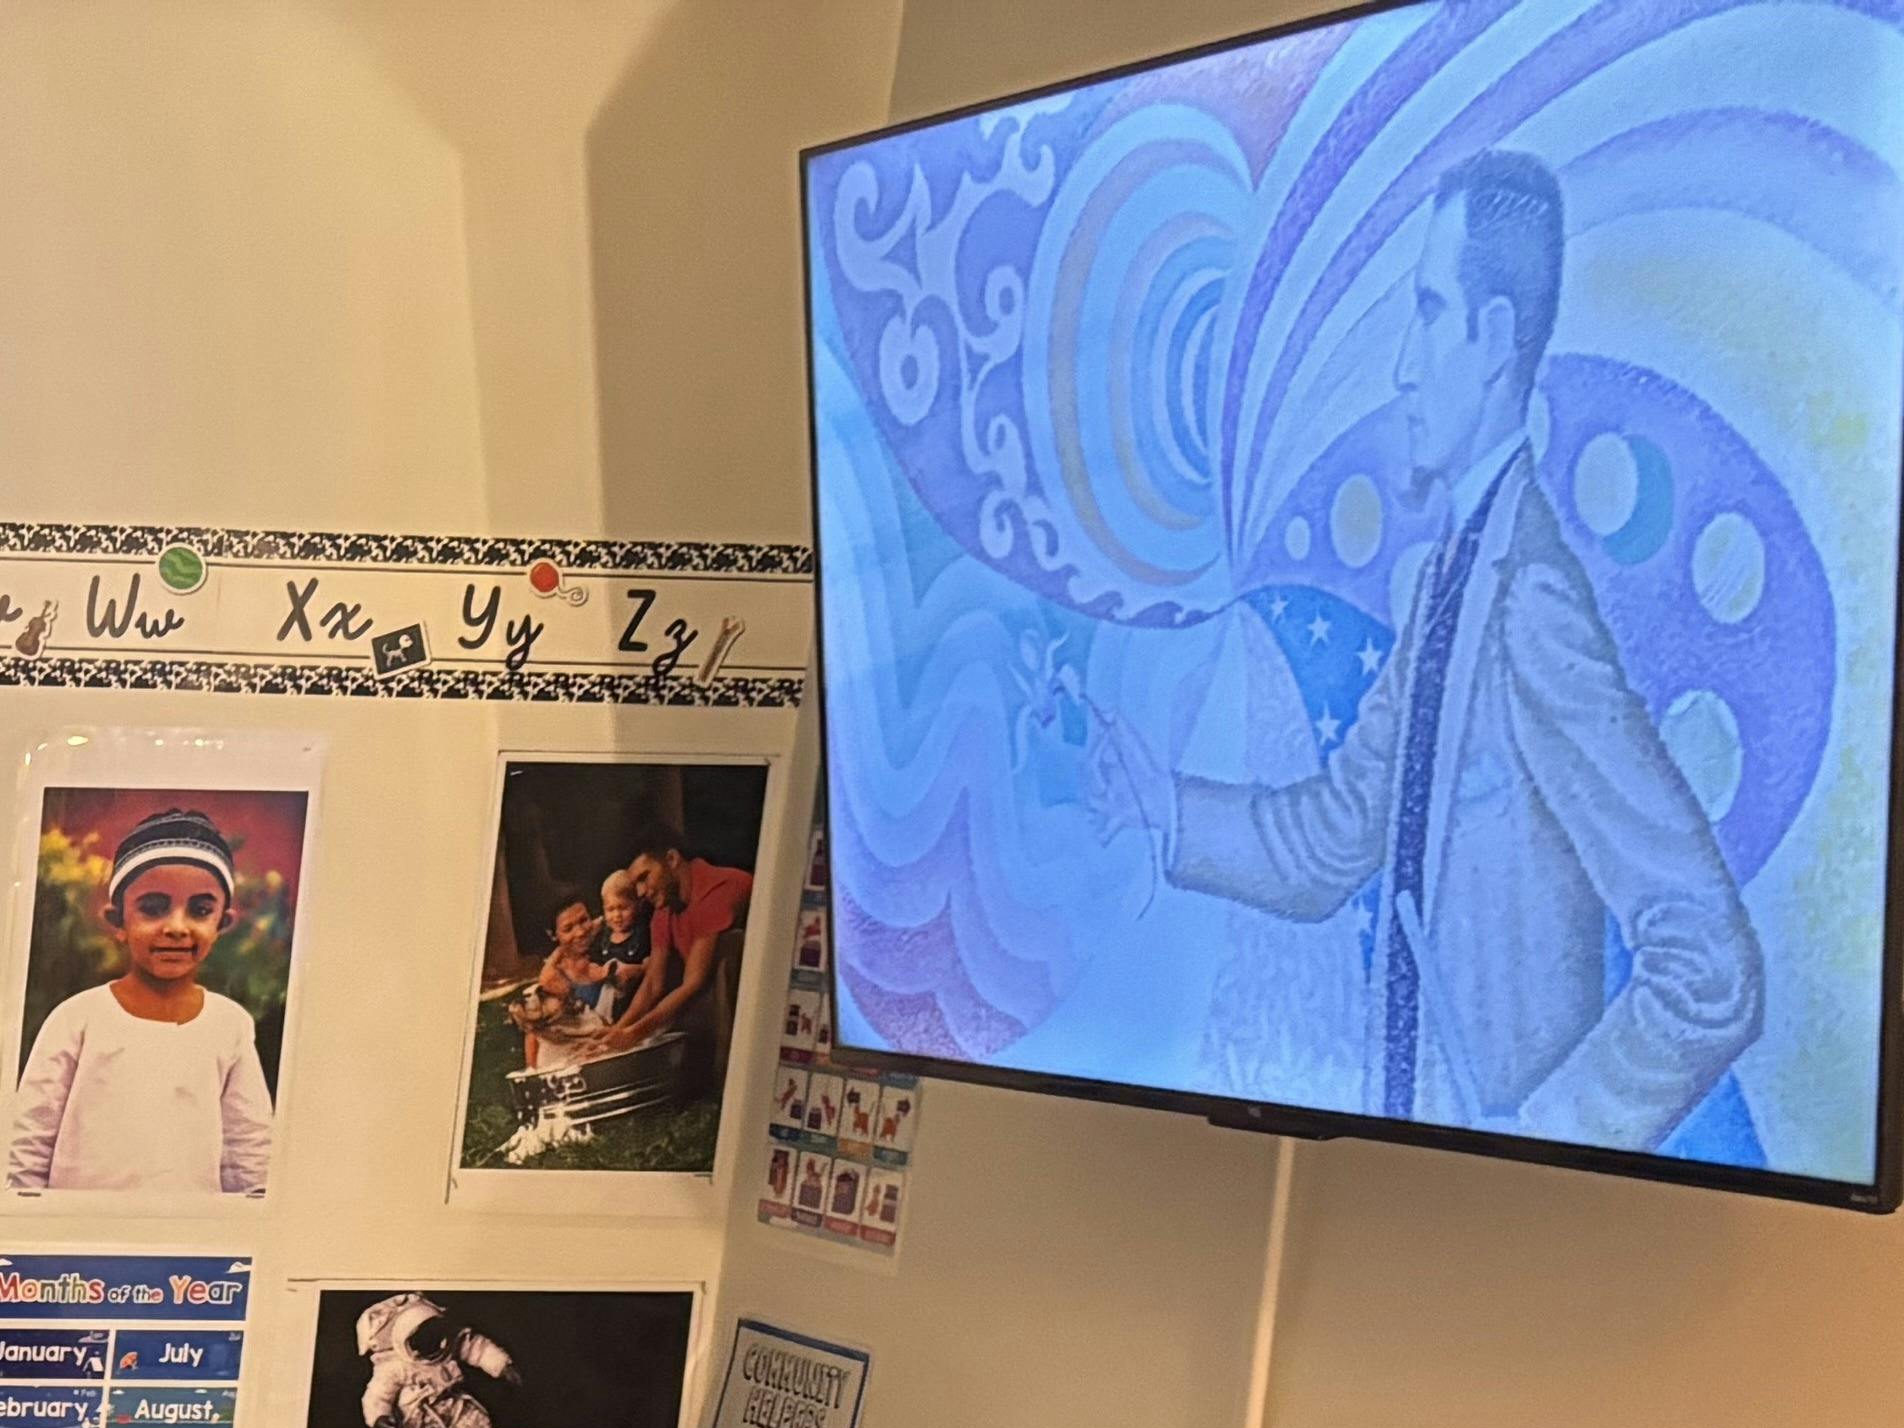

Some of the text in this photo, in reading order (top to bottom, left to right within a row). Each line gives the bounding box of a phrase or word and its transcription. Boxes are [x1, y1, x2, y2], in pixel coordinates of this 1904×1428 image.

[86, 573, 186, 638] Ww
[276, 579, 373, 642] Xx
[458, 584, 544, 670] Yy
[619, 591, 698, 677] Zz
[108, 1287, 129, 1304] of
[133, 1285, 163, 1302] the
[169, 1275, 242, 1304] Year
[158, 1343, 203, 1367] July
[743, 1342, 851, 1409] COMMUNITY
[134, 1399, 211, 1424] August
